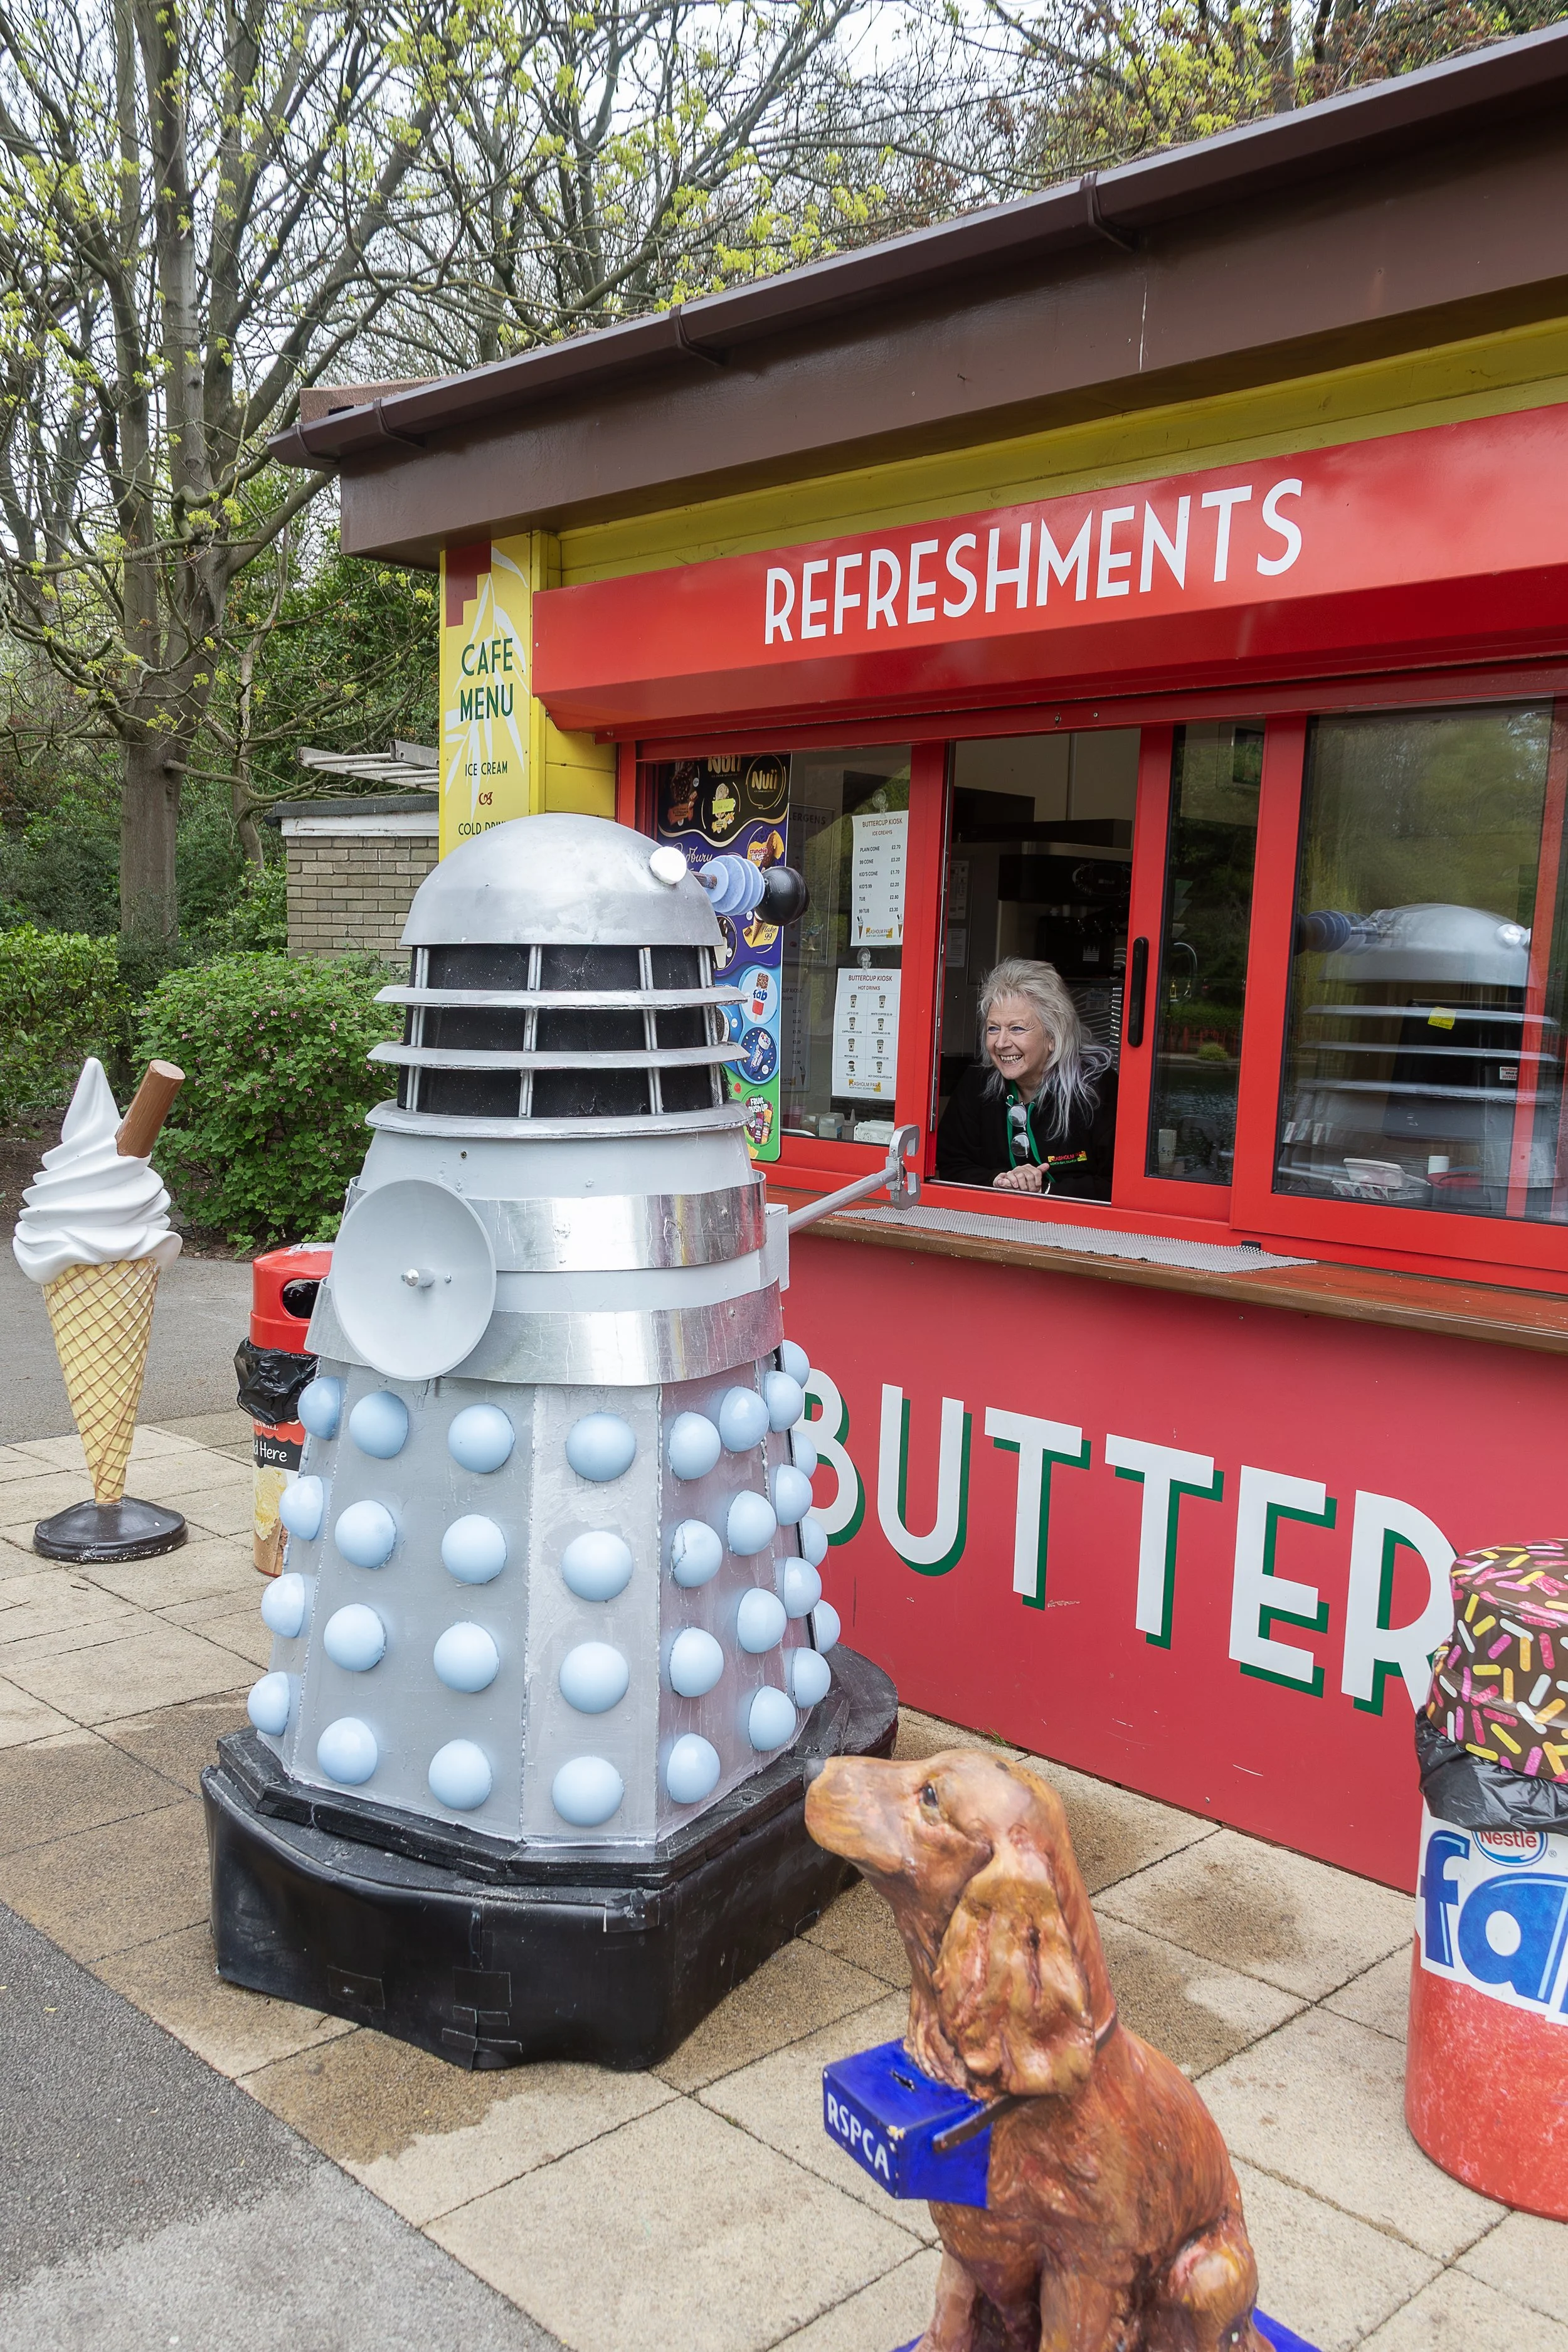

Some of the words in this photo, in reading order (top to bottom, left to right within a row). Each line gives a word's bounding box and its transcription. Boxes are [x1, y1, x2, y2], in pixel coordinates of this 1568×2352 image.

[765, 478, 1303, 644] REFRESHMENTS
[462, 638, 512, 676] CAFE
[460, 683, 513, 721] MENU
[465, 764, 477, 776] ICE
[481, 761, 507, 775] CREAM
[751, 769, 778, 790] Nuii
[458, 822, 481, 835] COLD
[862, 819, 887, 827] BUTTERCUP
[753, 989, 768, 1001] fab
[260, 1441, 287, 1462] Here
[795, 1369, 1459, 1715] BUTTER
[1420, 1830, 1568, 2015] fa
[827, 2092, 890, 2181] RSPCA
